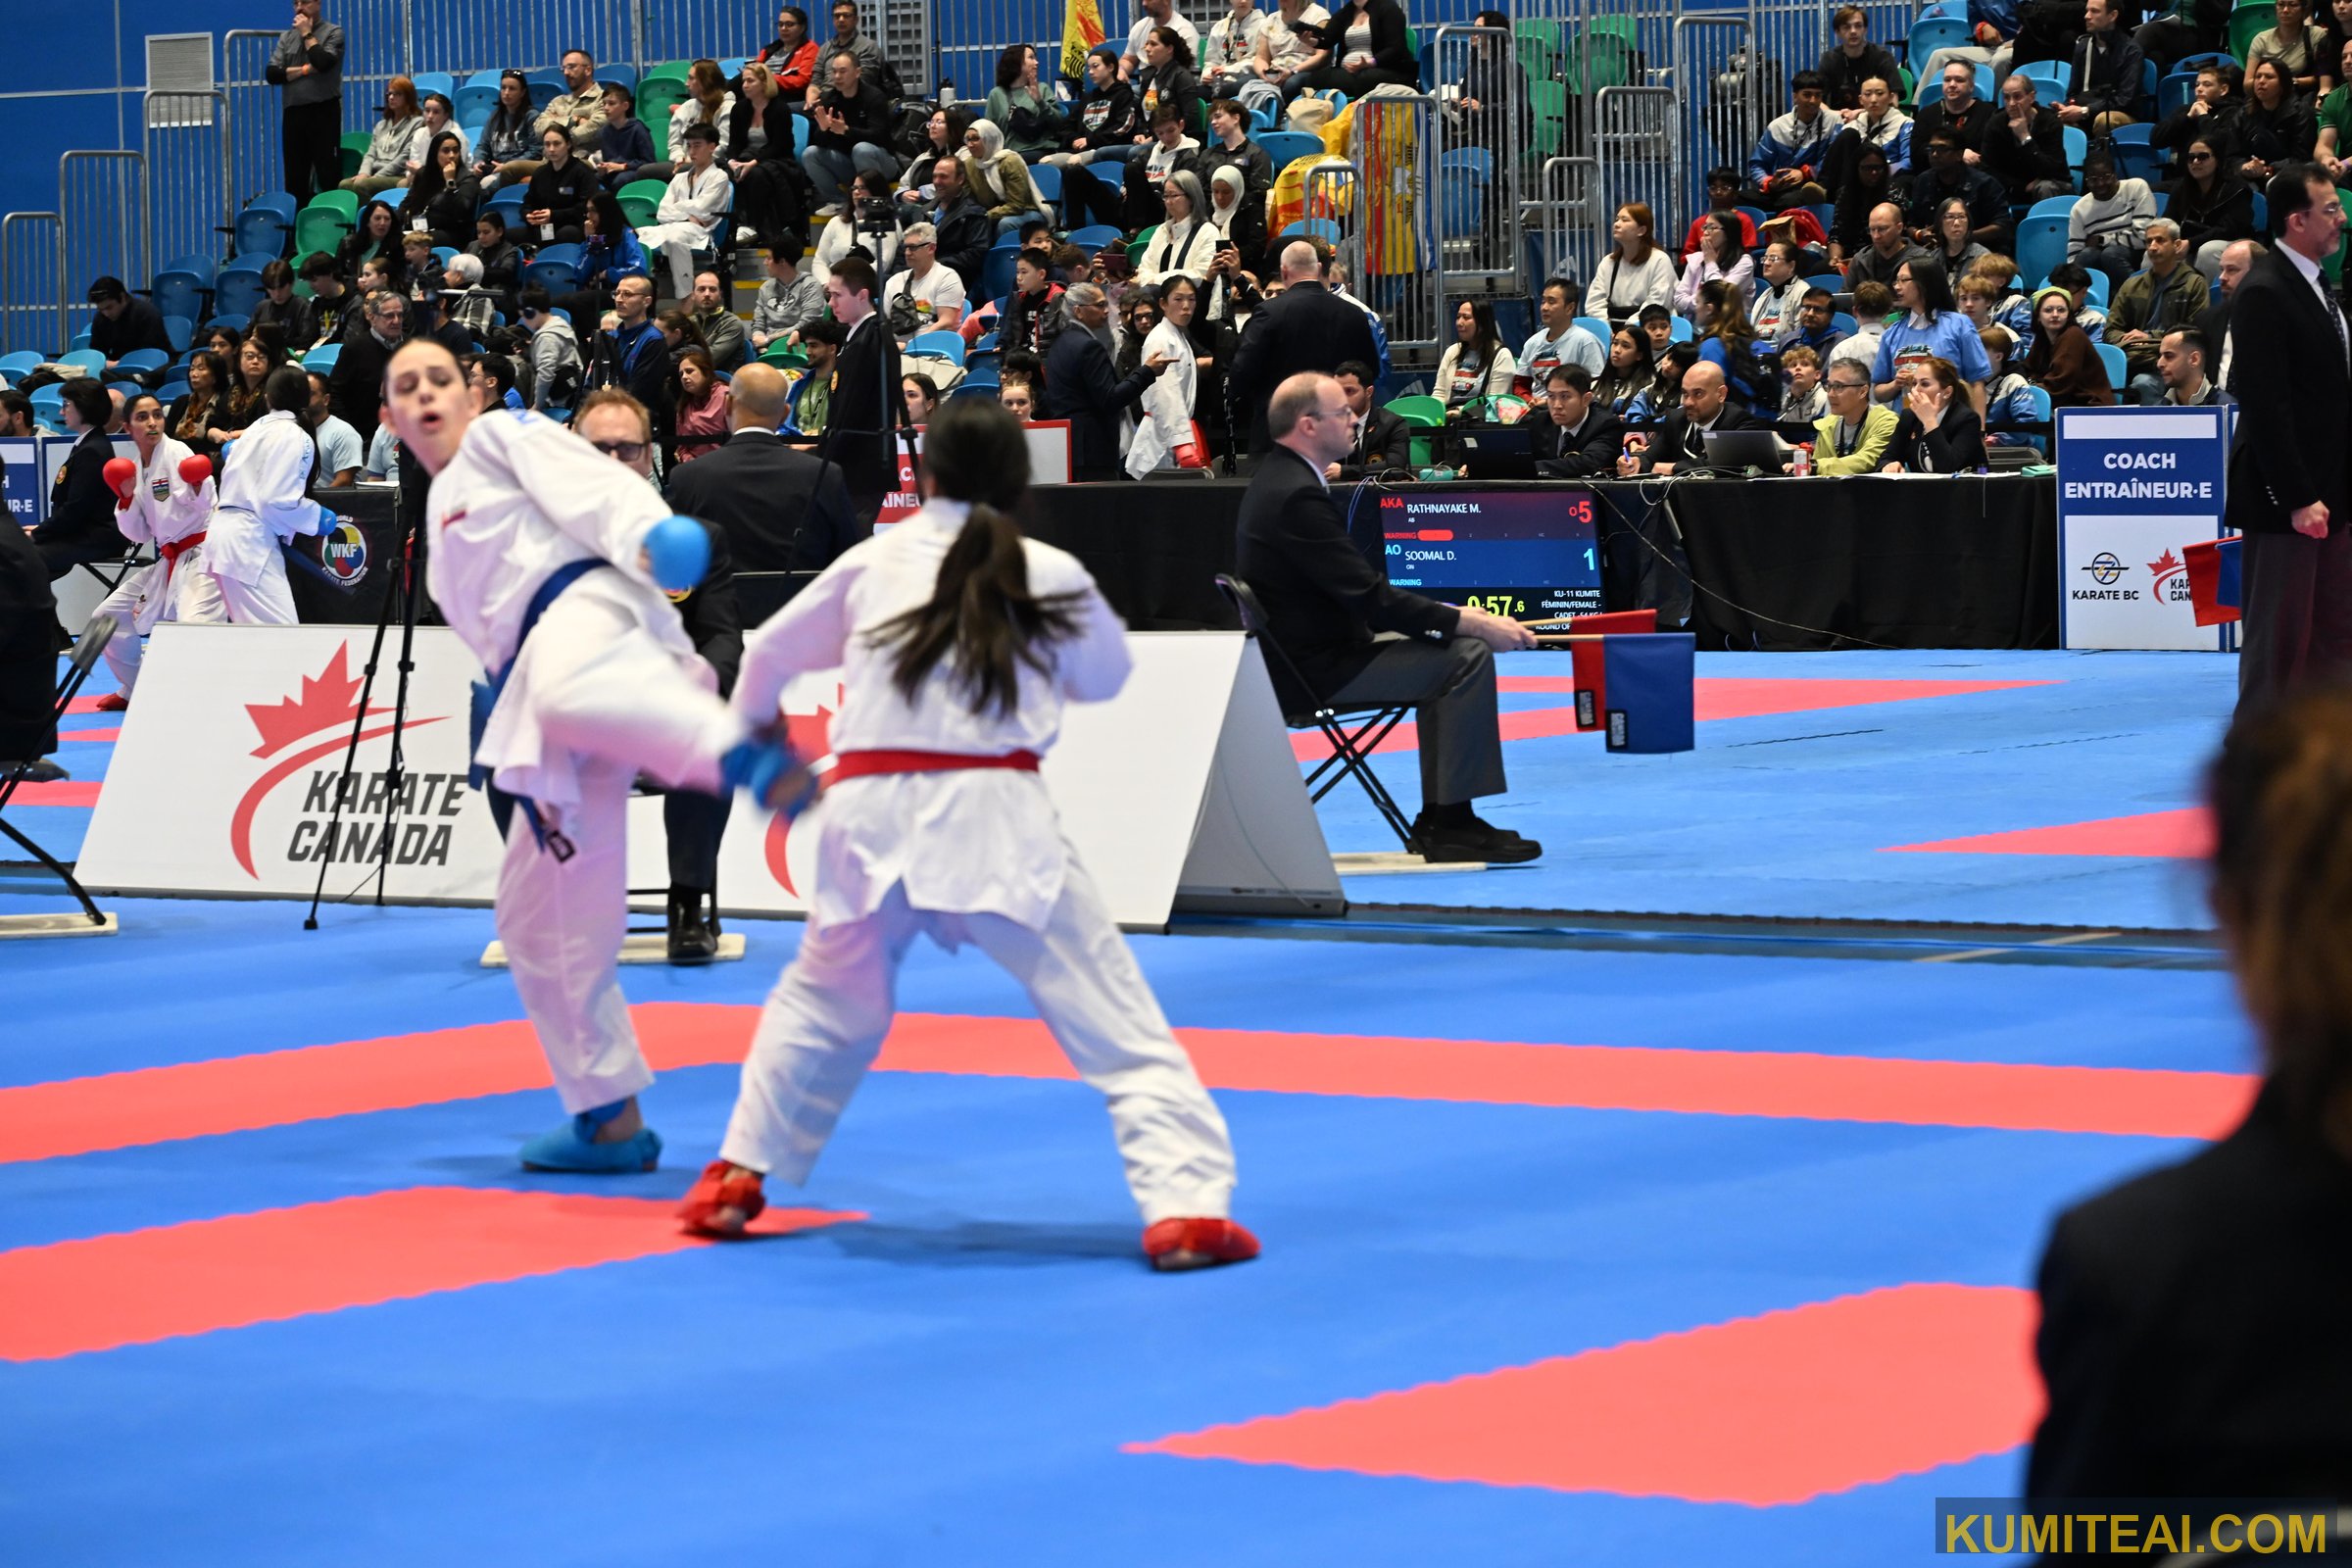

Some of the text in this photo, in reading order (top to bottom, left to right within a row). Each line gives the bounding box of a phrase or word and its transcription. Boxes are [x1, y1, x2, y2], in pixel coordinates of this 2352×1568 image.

[2103, 453, 2177, 469] COACH
[2064, 477, 2213, 499] ENTRAÎNEUR·E
[1379, 497, 1404, 509] AKA
[1406, 503, 1482, 514] RATHNAYAKE M.
[330, 543, 358, 559] WKF
[1385, 544, 1402, 555] AO
[1404, 550, 1457, 561] SOOMAL D.
[1583, 547, 1595, 570] 1
[2072, 590, 2140, 601] KARATE BC
[302, 770, 468, 816] KARATE
[286, 820, 453, 866] CANADA
